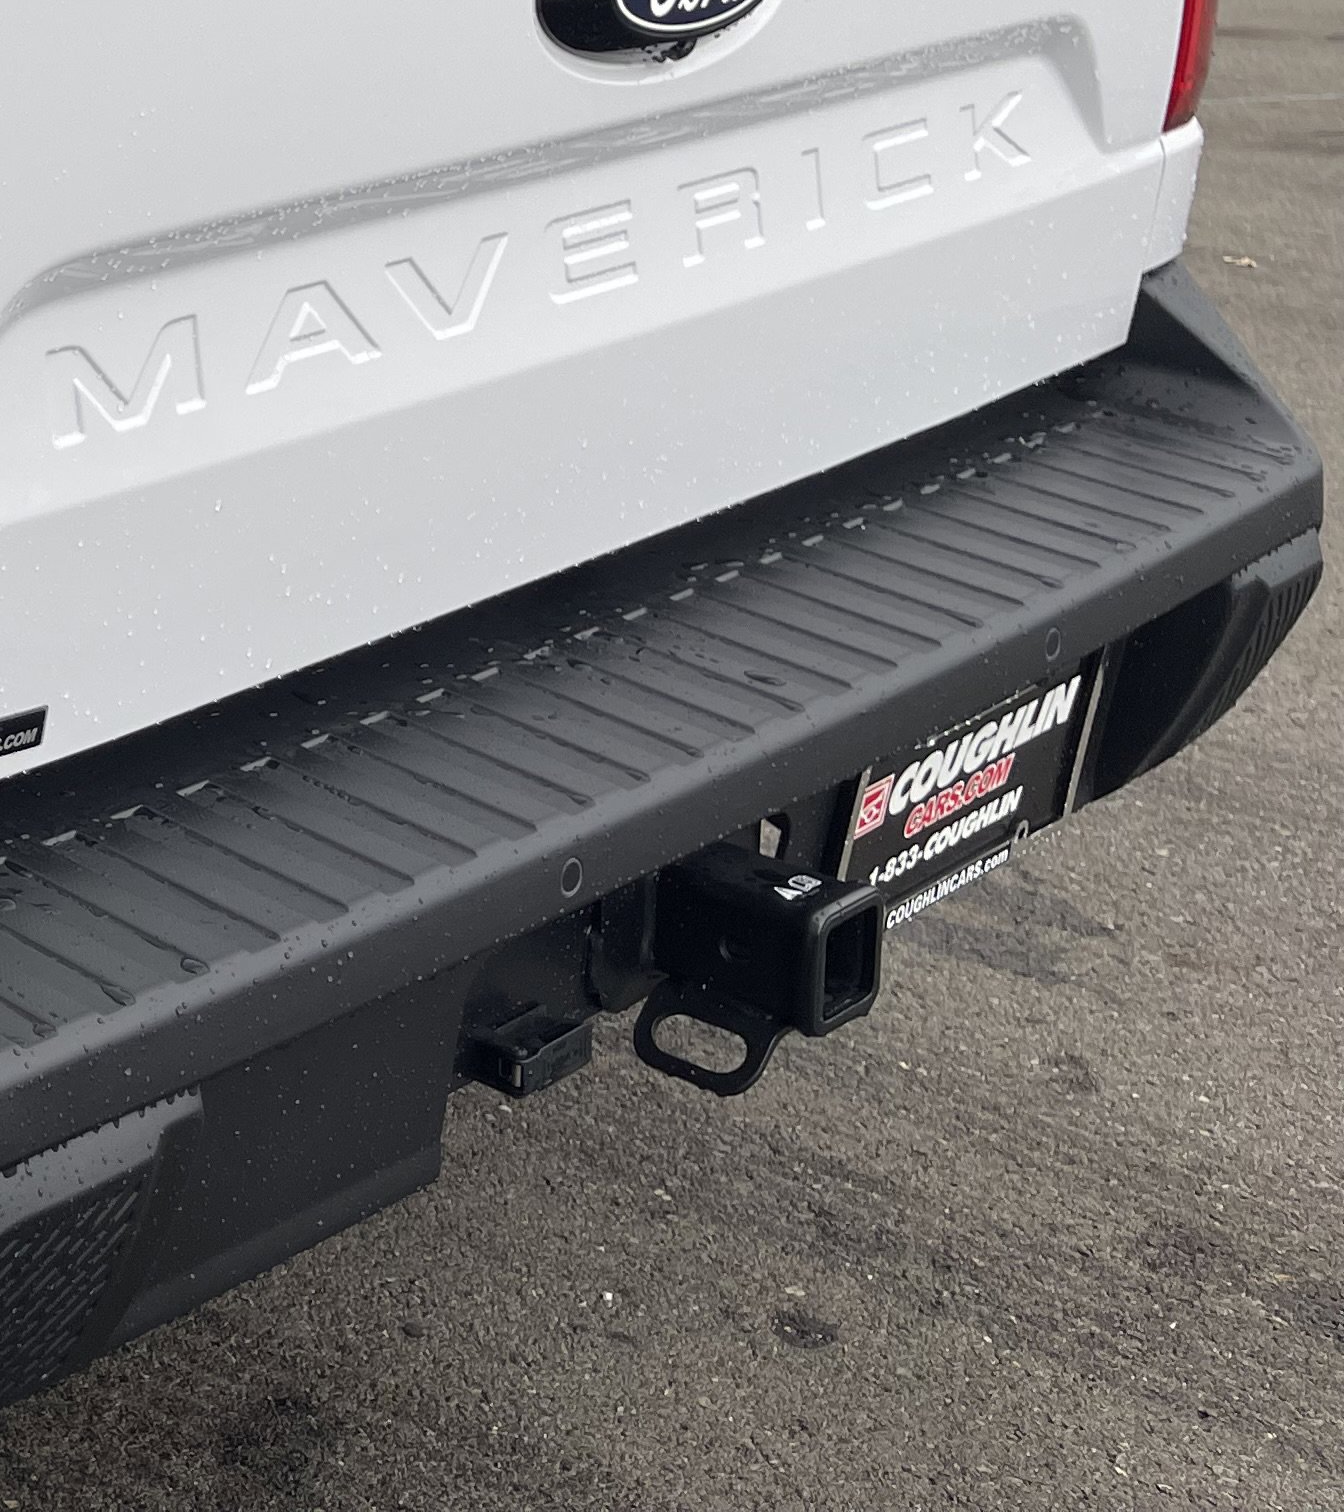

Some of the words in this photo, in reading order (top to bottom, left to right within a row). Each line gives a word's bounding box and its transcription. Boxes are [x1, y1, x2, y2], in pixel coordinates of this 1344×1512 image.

[44, 90, 1032, 450] MAVERICK
[888, 675, 1082, 816] COUGHLIN
[903, 753, 1015, 839] CARS.COM
[869, 785, 1023, 887] 1-833-COUGHLIN
